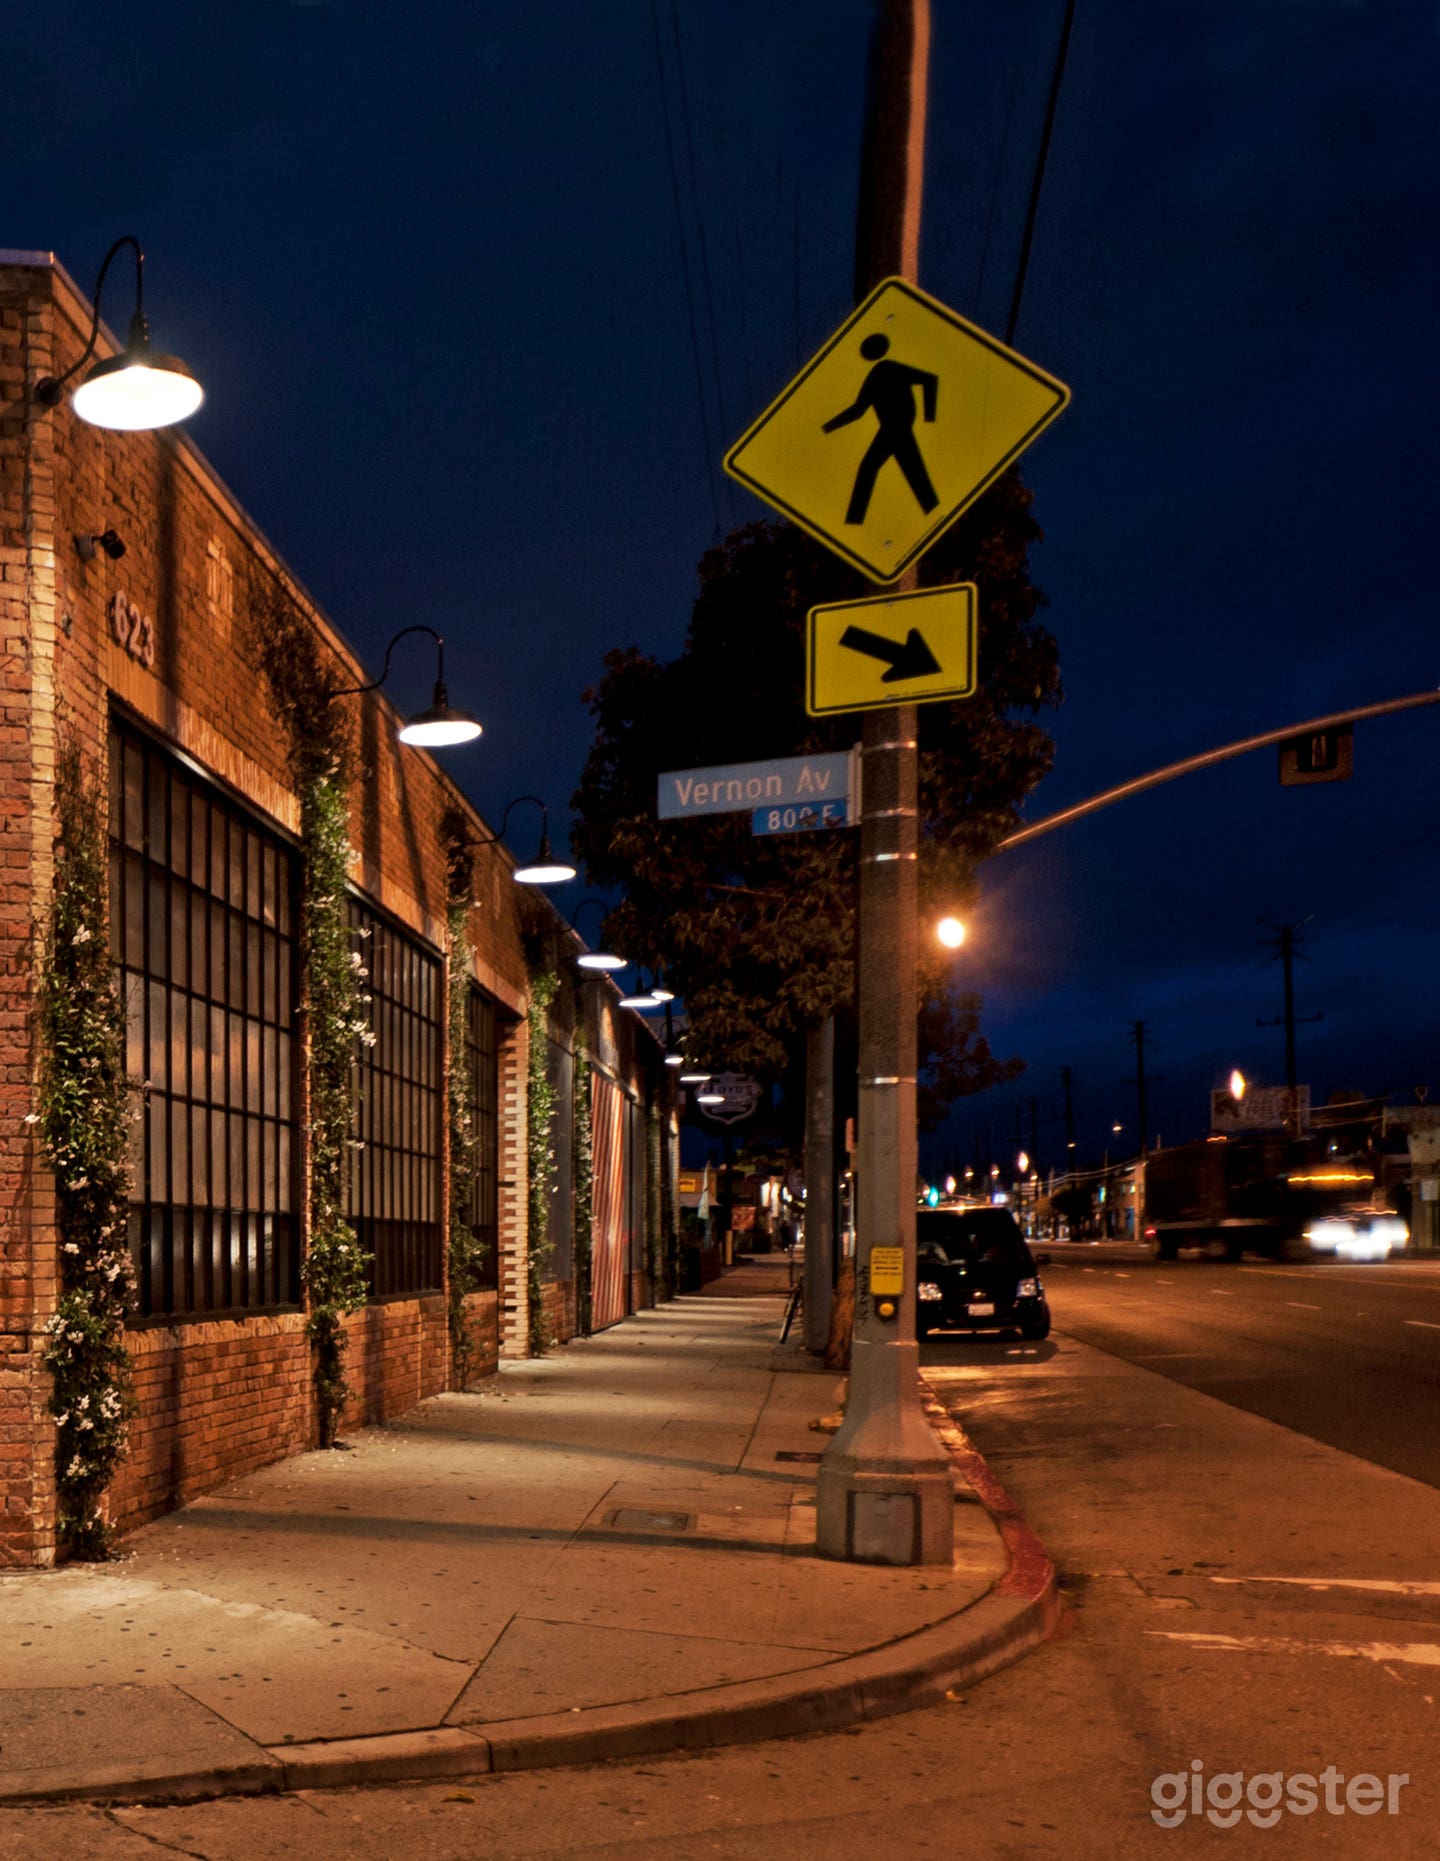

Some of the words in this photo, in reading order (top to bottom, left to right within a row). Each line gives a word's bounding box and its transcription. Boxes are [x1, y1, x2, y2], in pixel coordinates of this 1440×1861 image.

[114, 590, 155, 667] 623
[675, 773, 783, 807] Vernon
[796, 765, 832, 794] Av
